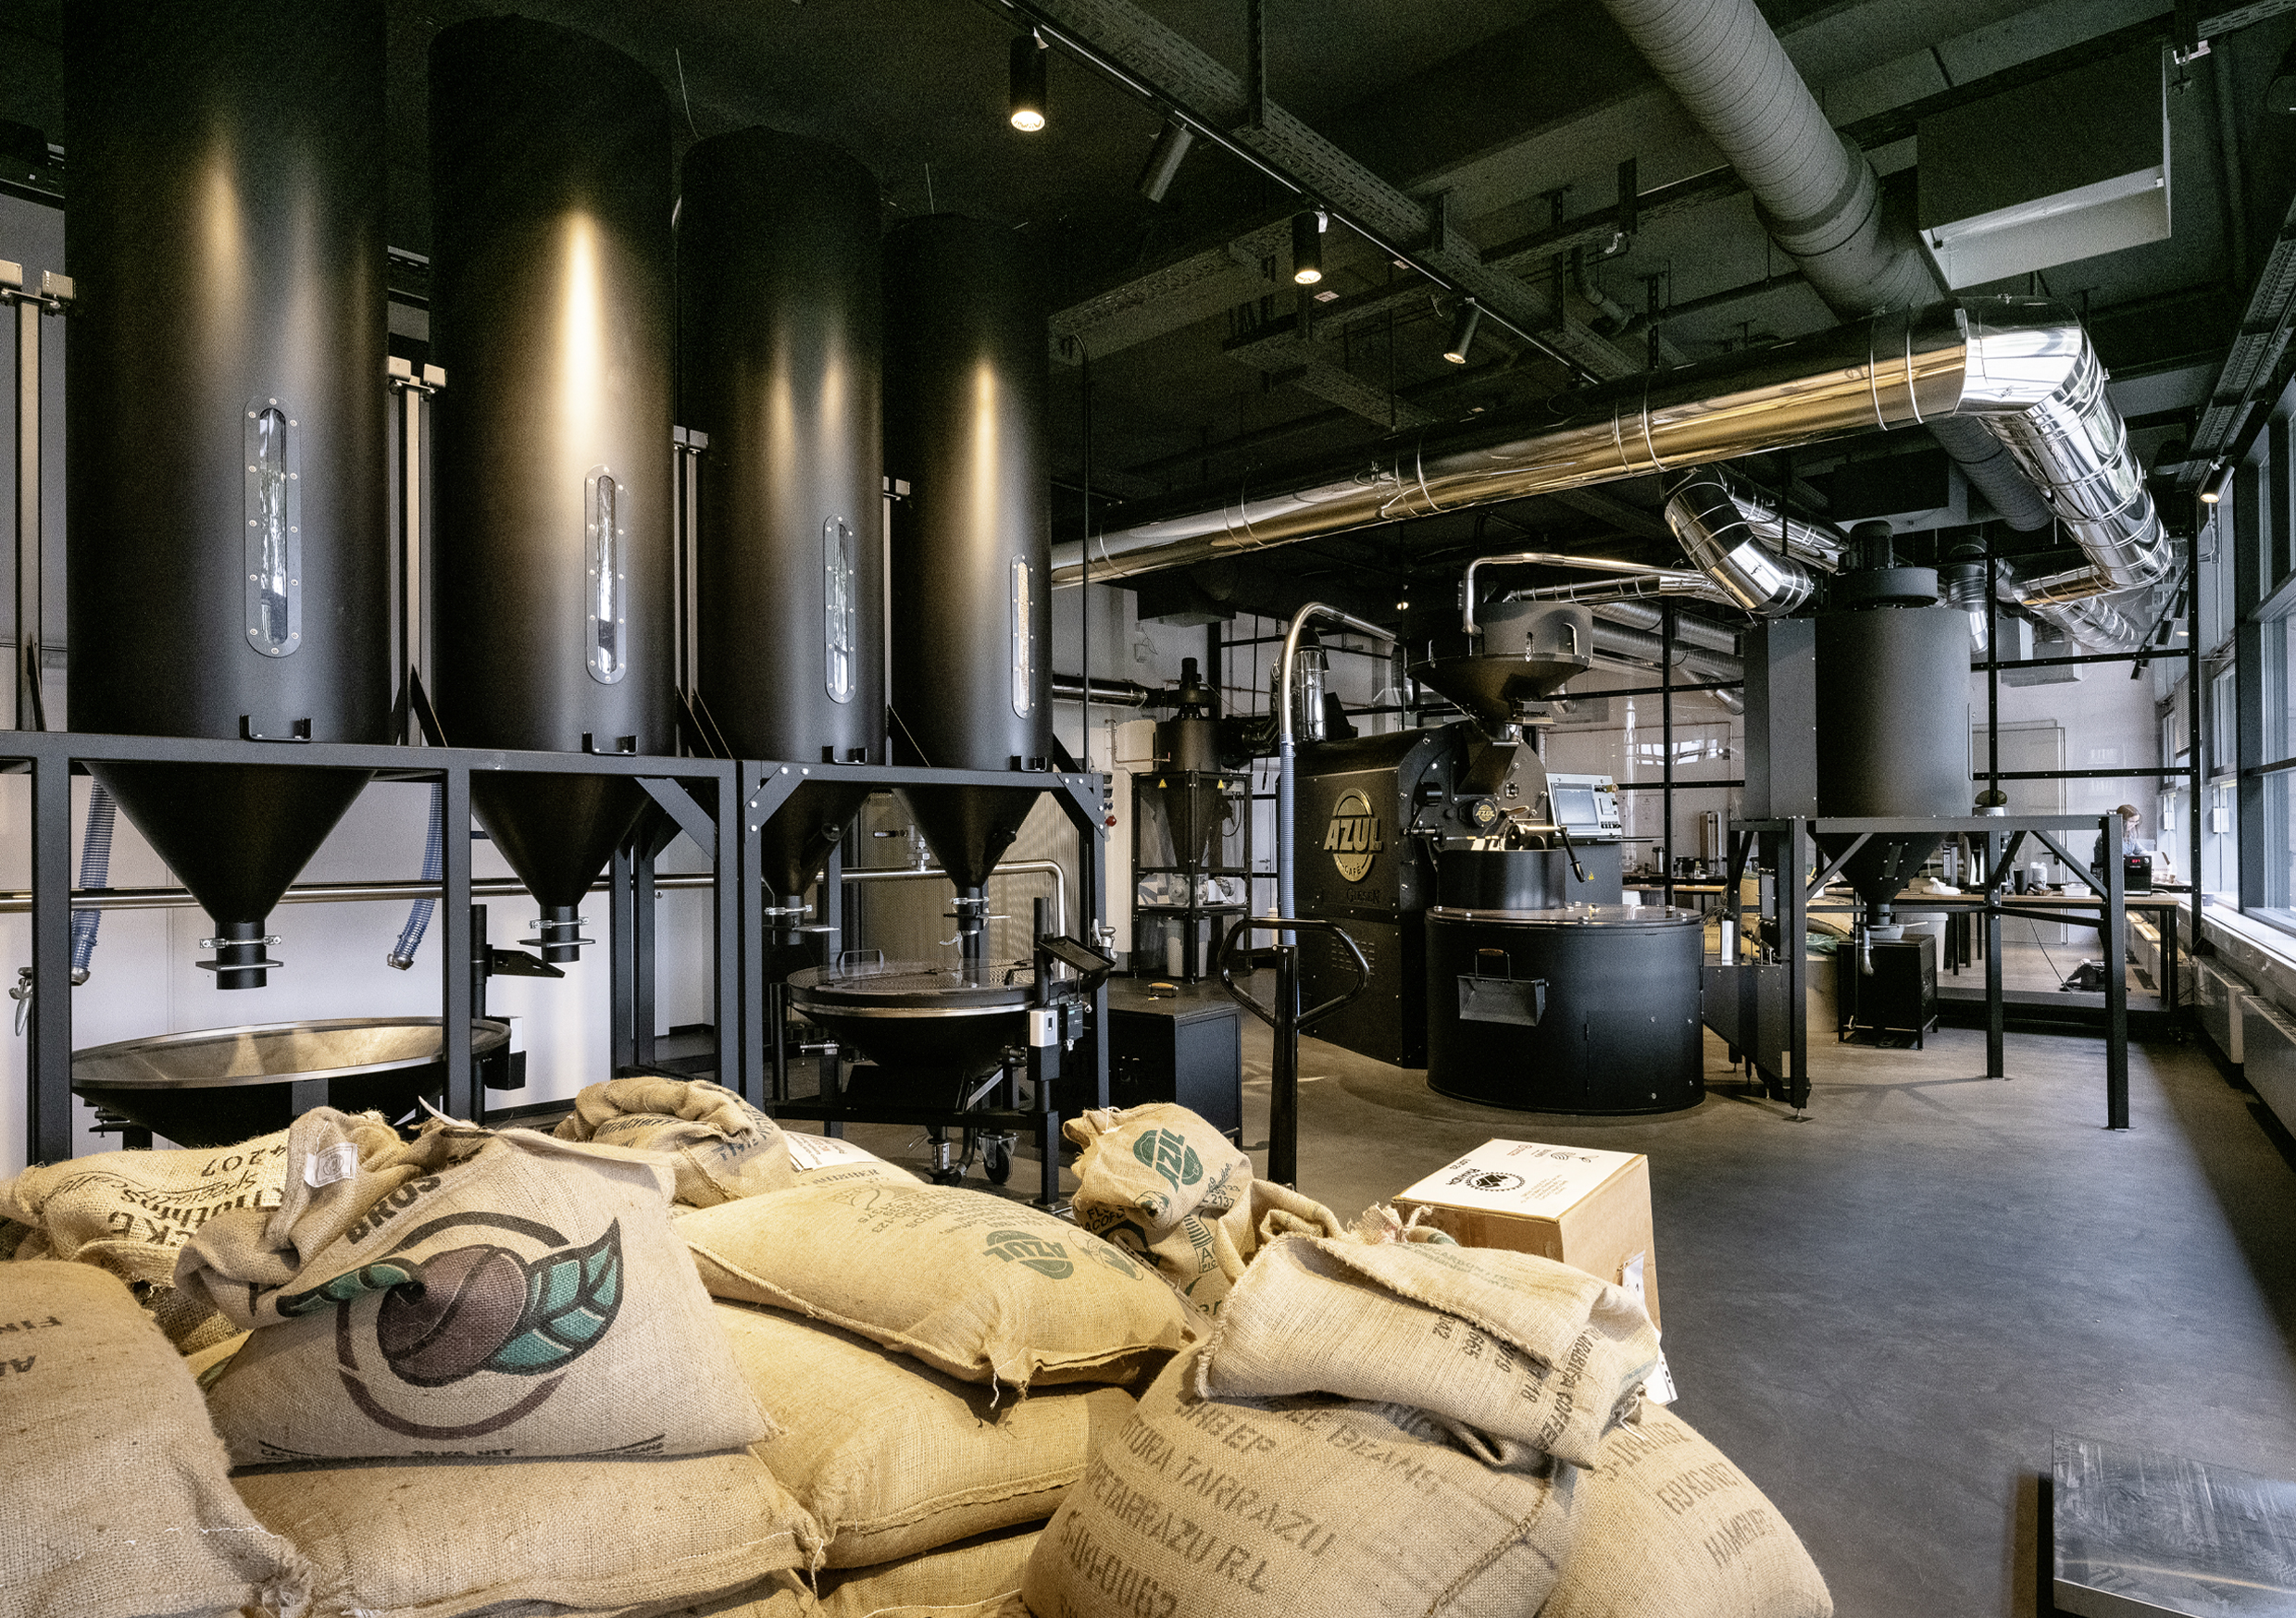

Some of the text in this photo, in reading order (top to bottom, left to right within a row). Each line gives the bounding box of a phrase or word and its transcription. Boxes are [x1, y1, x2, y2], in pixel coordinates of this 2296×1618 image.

[1323, 818, 1382, 852] AZUL
[982, 1240, 1069, 1263] AZUL
[1176, 1454, 1338, 1557] TARRAZU
